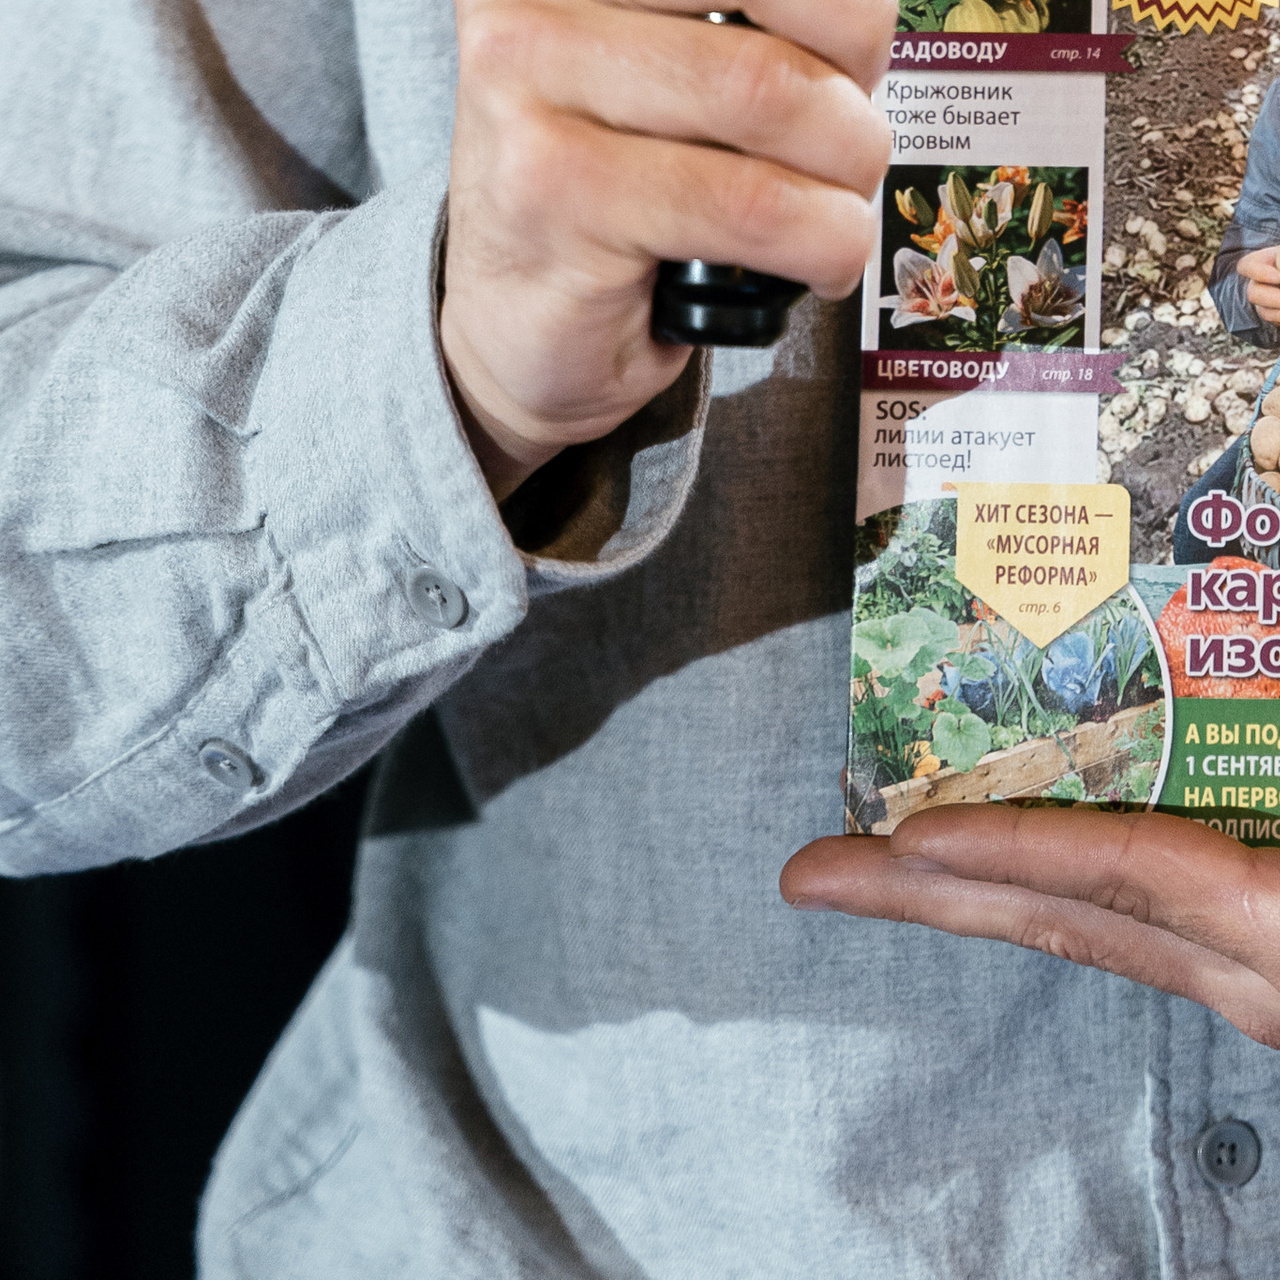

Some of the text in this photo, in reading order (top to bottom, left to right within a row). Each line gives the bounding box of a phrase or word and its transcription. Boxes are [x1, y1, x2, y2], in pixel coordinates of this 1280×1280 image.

[890, 41, 1102, 63] САДОВОДУ стр. 14
[887, 80, 1013, 104] Крыжовник
[886, 105, 1021, 126] тоже бывает
[877, 360, 1094, 383] ЦВЕТОВОДУ стр. 18
[876, 400, 927, 421] SOS:
[874, 429, 1036, 450] лилии атакует
[873, 450, 972, 472] листоед!
[974, 504, 1012, 523] ХИТ
[1016, 504, 1089, 525] СЕЗОНА
[987, 535, 1100, 556] «МУСОРНАЯ
[995, 564, 1097, 586] РЕФОРМА»
[1018, 601, 1061, 616] стр. 6
[1185, 723, 1200, 744] А
[1206, 723, 1240, 745] ВЫ
[1185, 755, 1195, 776] 1
[1184, 786, 1216, 807] НА
